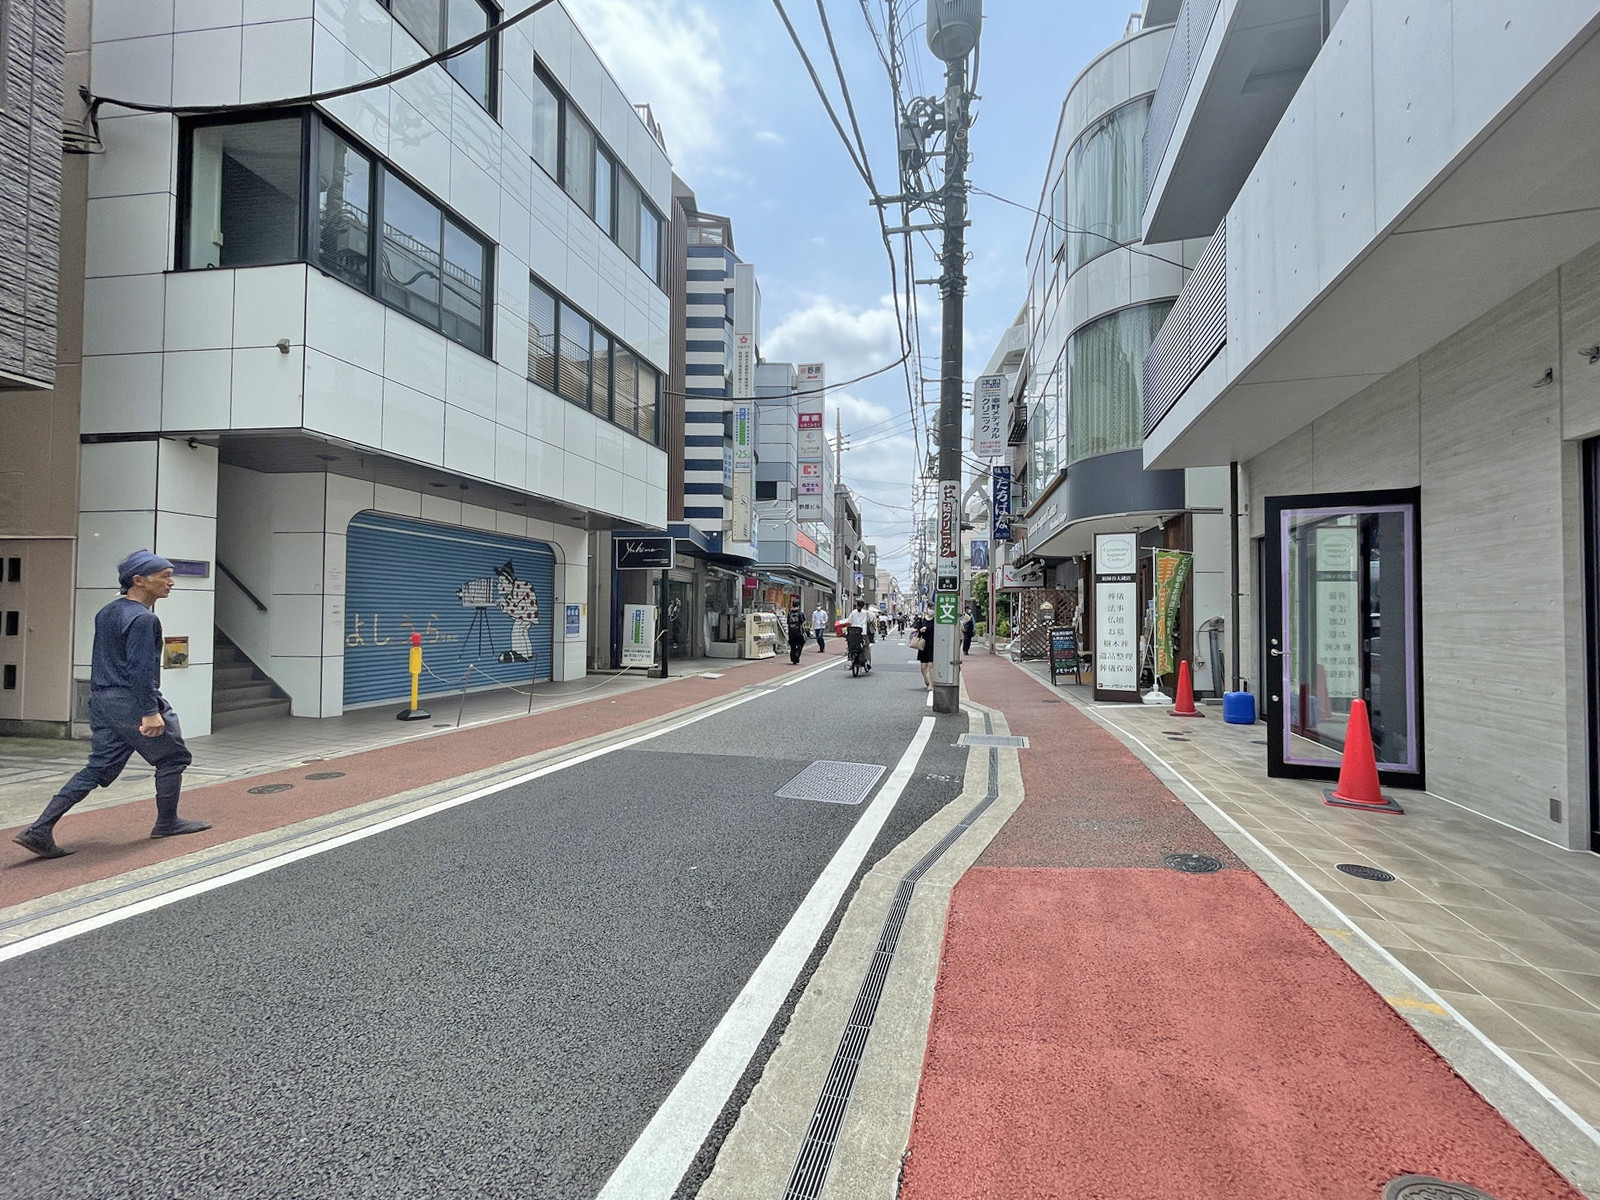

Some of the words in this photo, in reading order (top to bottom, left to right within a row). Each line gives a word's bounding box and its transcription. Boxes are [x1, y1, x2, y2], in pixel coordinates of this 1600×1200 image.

[981, 397, 991, 433] クリニック
[994, 476, 1009, 532] たちばな
[940, 602, 955, 619] 文
